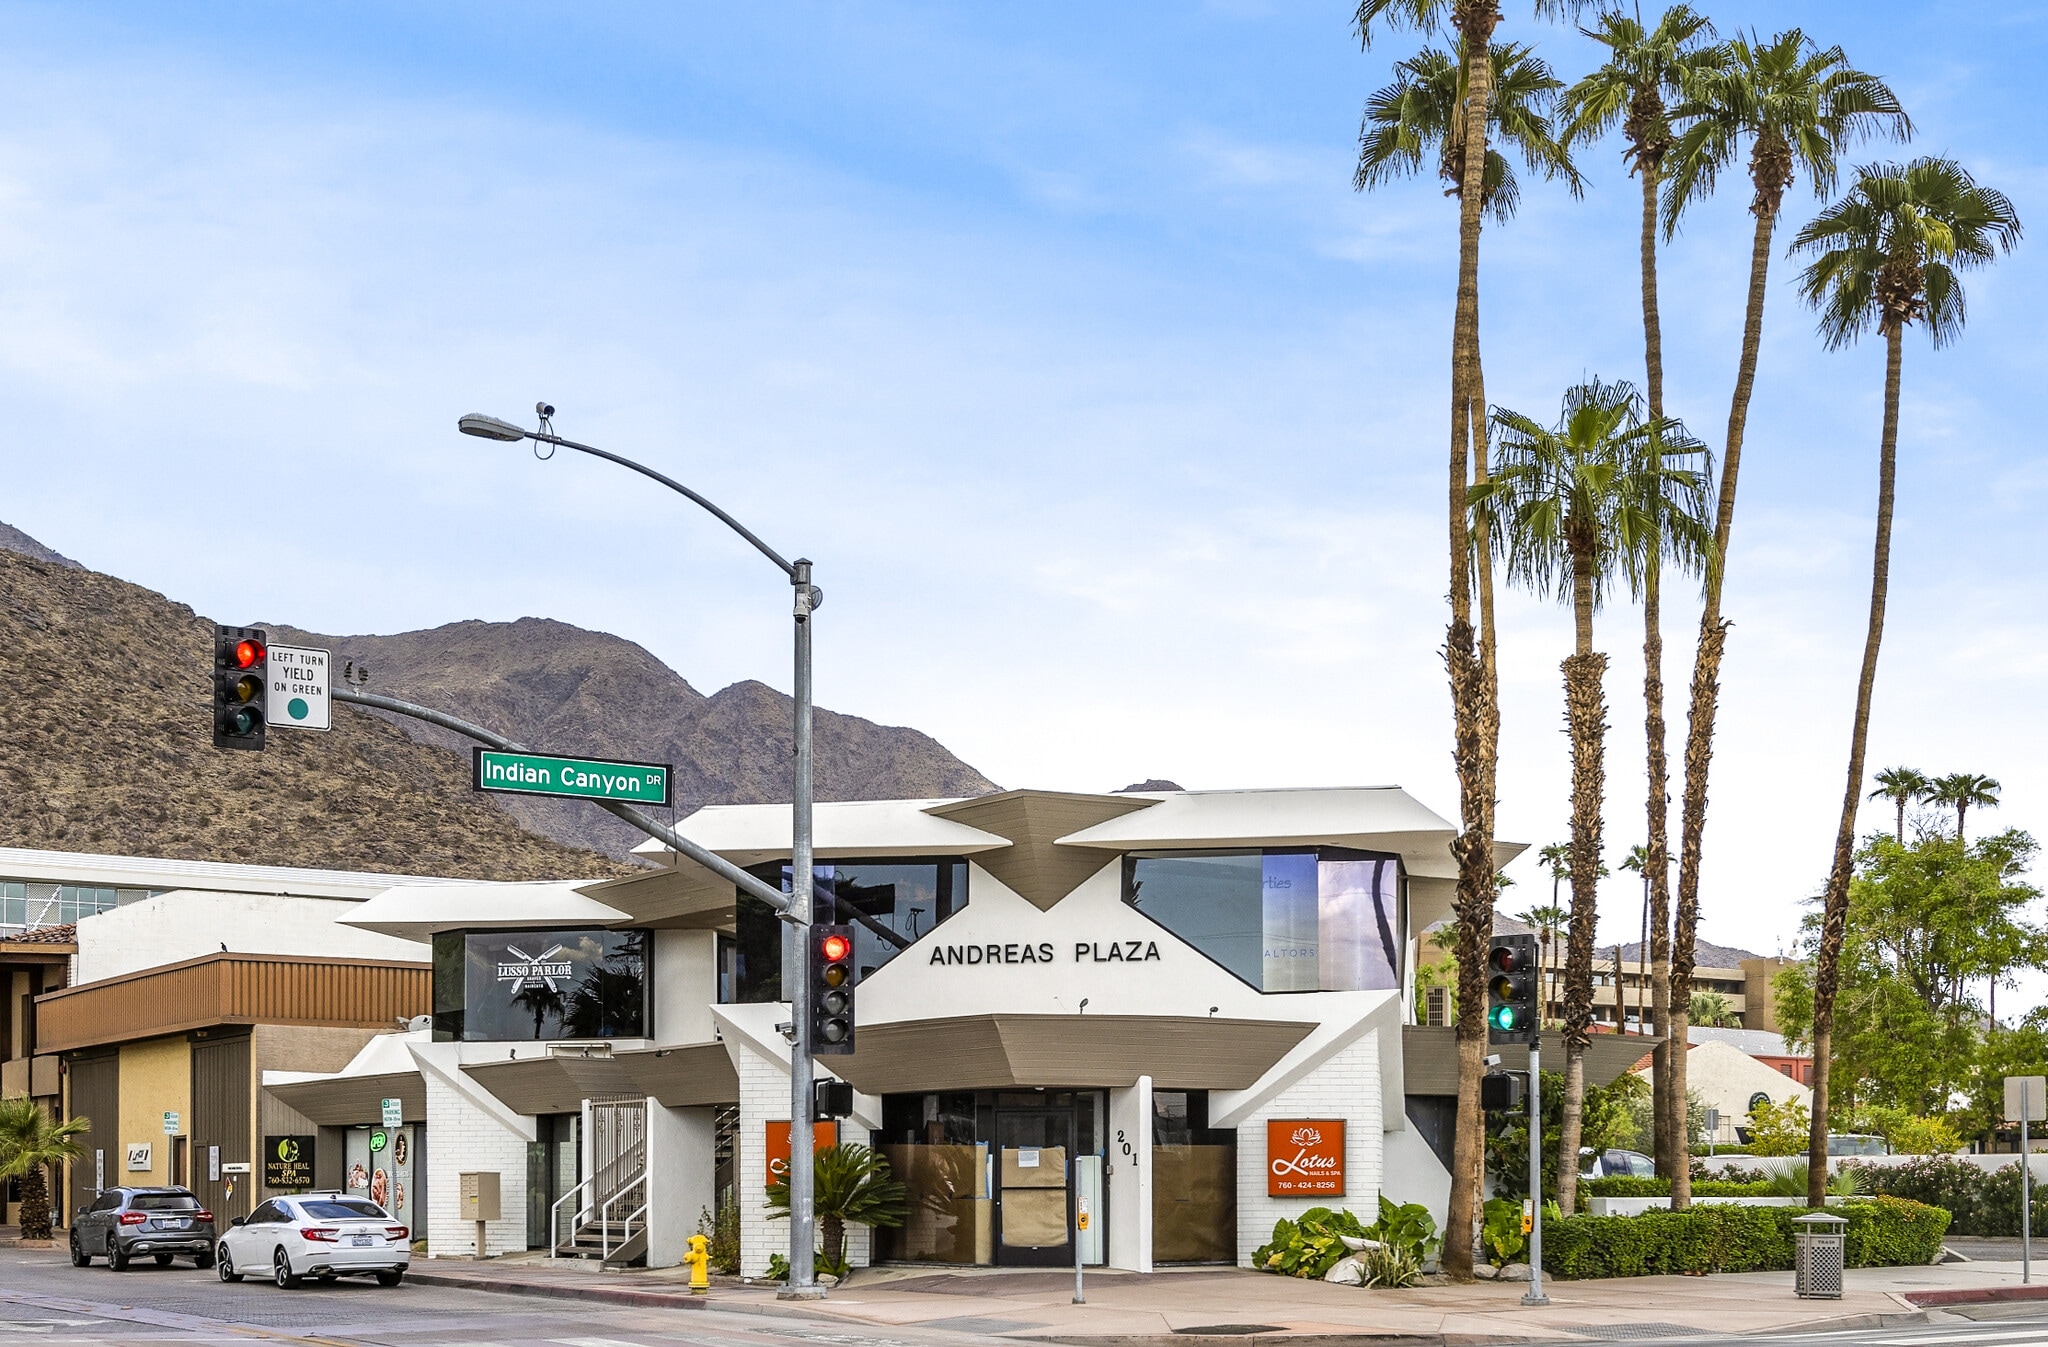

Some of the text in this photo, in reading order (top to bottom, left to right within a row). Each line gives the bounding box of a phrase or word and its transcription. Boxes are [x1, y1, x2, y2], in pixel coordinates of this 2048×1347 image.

[272, 652, 324, 666] LEFT TURN
[283, 666, 314, 681] YIELD
[274, 682, 322, 696] ON GREEN
[486, 759, 662, 794] Indian Canyon DR
[929, 941, 1161, 966] ANDREAS PLAZA
[497, 965, 572, 976] LUSSO PARLOR
[1117, 1129, 1139, 1167] 201
[267, 1162, 310, 1170] NATURE HEAL
[1272, 1148, 1337, 1176] Lotus
